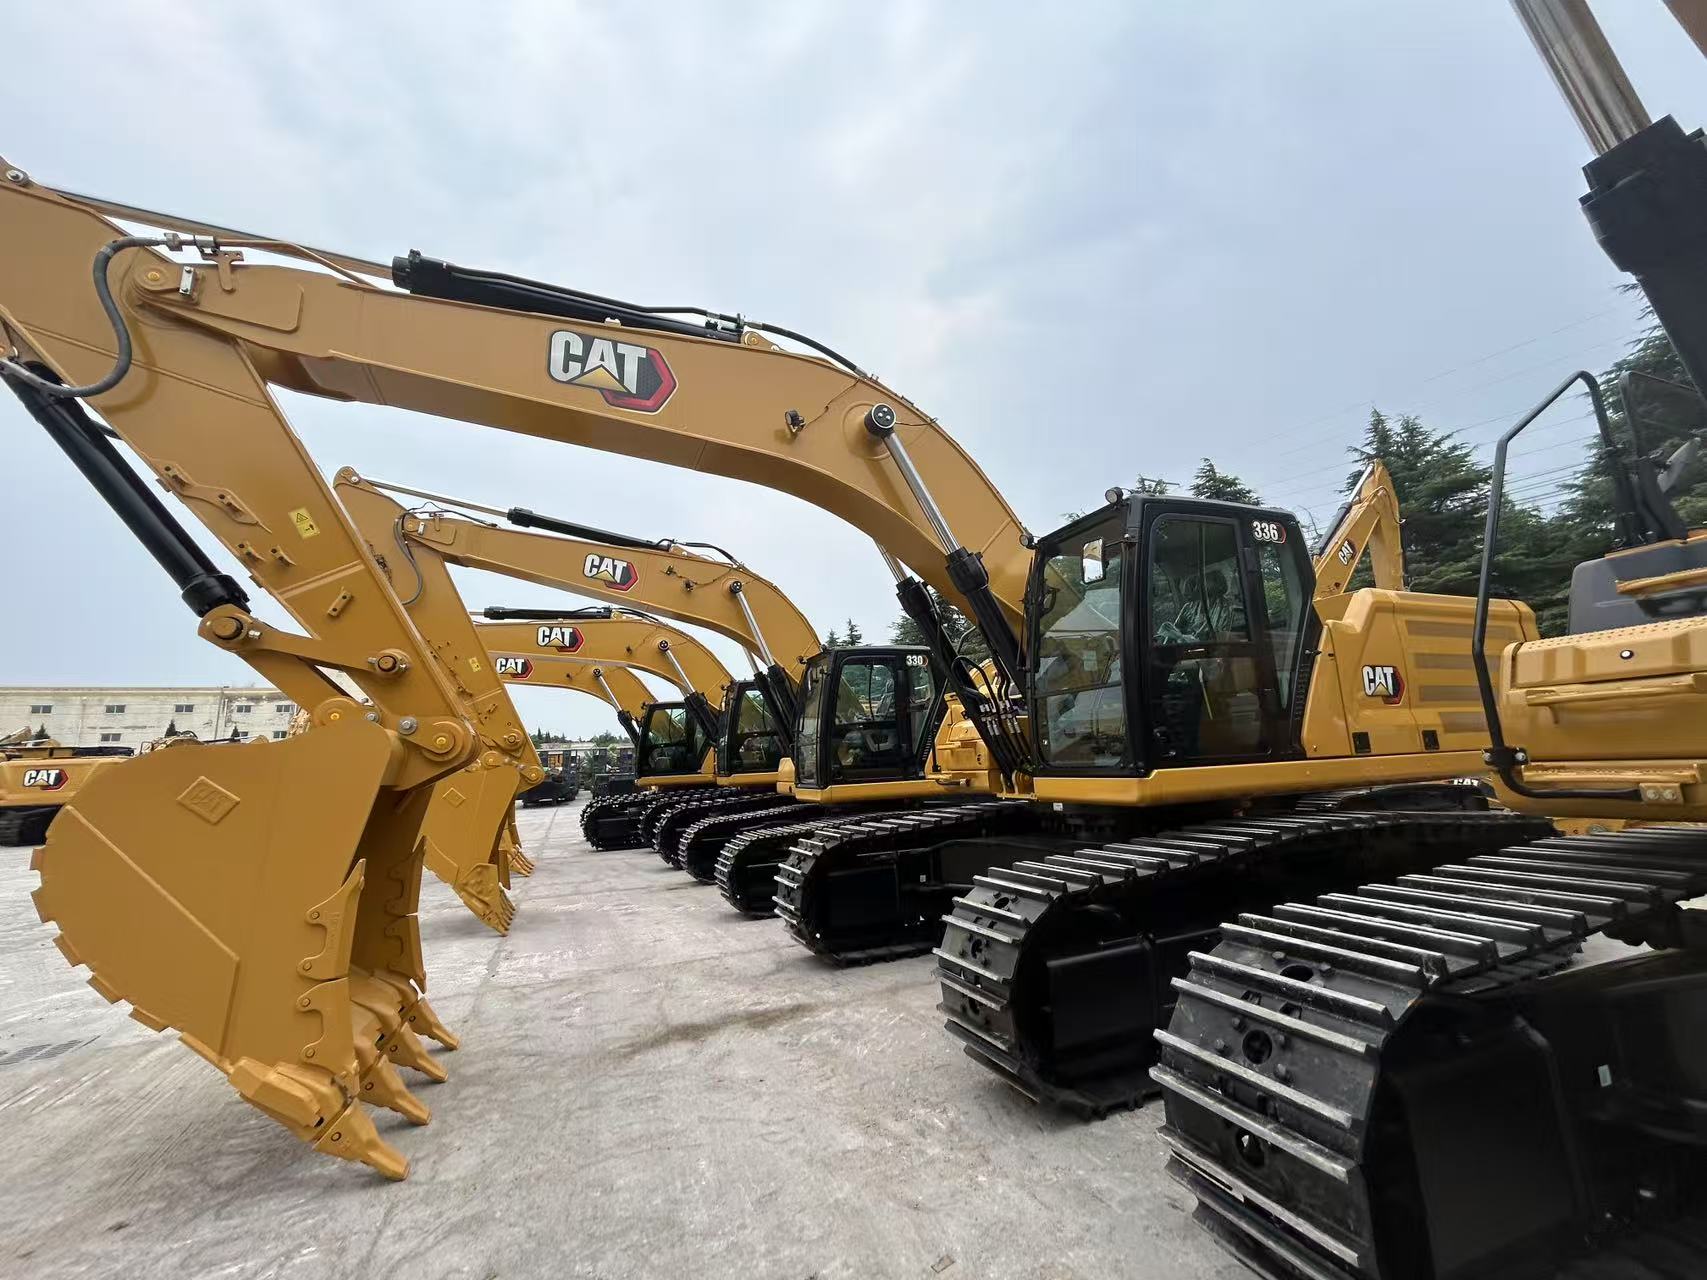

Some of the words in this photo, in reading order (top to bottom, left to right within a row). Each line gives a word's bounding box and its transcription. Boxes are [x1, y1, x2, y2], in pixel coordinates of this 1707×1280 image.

[550, 331, 647, 394] CAT
[1252, 521, 1279, 541] 336
[1338, 540, 1354, 565] CAT
[583, 554, 628, 583] CAT
[537, 626, 573, 647] CAT
[496, 658, 525, 674] CAT
[906, 655, 923, 665] 330
[1362, 665, 1394, 696] CAT
[23, 770, 60, 787] CAT
